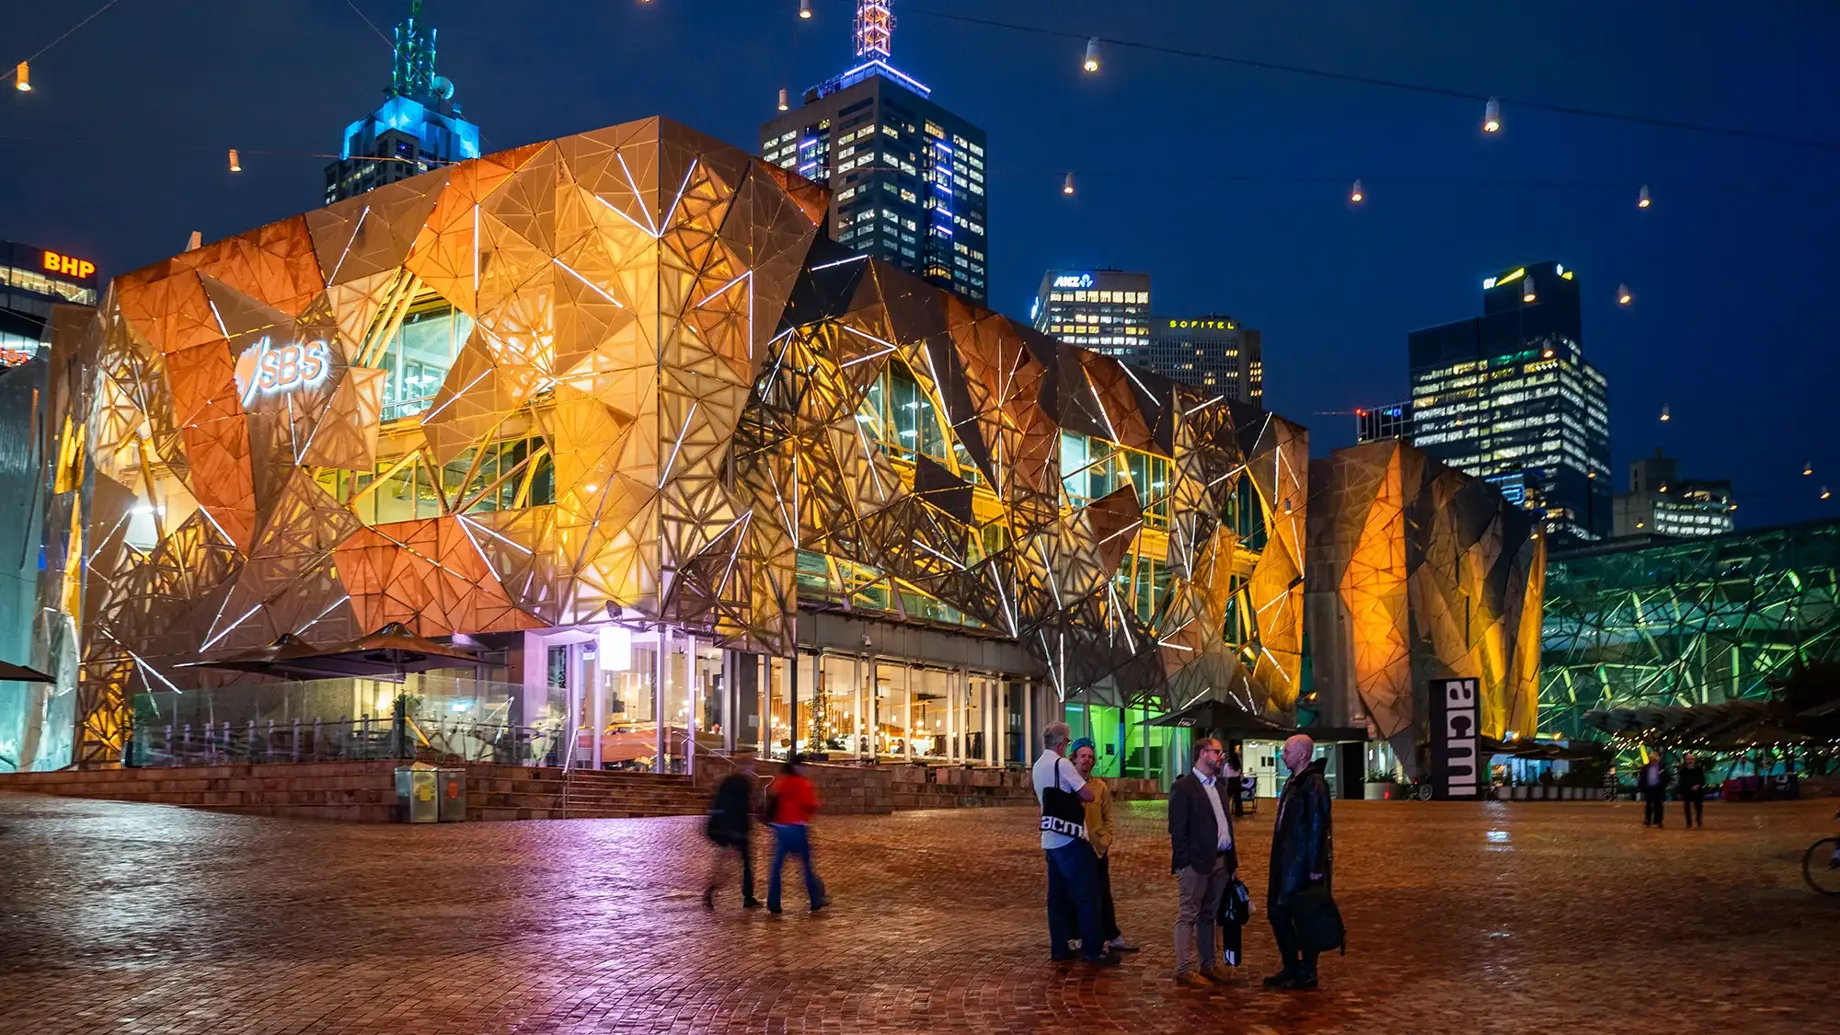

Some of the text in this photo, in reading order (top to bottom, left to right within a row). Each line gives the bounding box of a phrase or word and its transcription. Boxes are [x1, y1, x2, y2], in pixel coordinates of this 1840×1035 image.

[44, 250, 96, 279] BHP
[1169, 319, 1235, 330] SOFITEL
[259, 340, 323, 389] SBS
[1446, 680, 1477, 796] acmi
